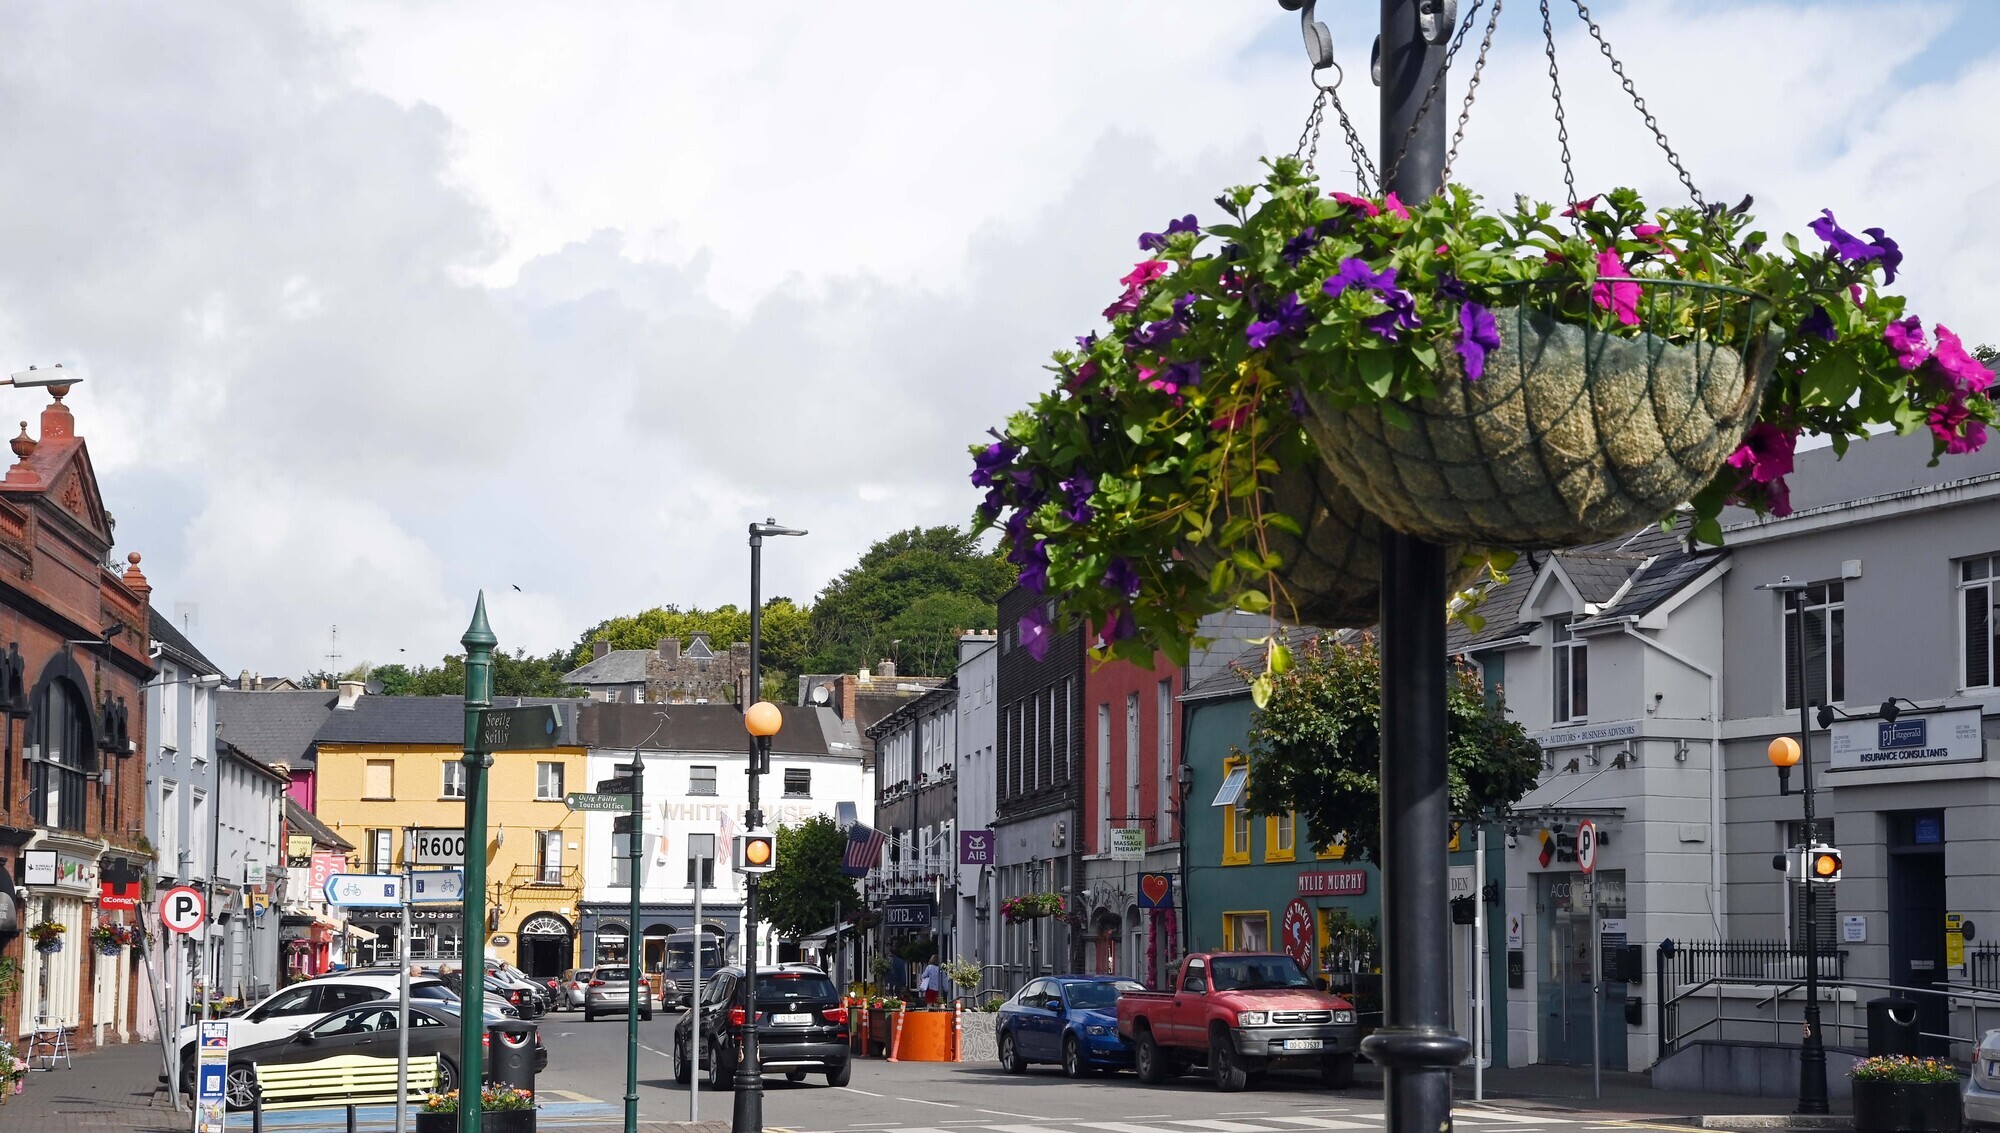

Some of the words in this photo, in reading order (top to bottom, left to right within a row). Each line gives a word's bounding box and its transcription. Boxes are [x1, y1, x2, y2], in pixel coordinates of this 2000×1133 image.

[485, 713, 511, 729] Sceilg
[484, 729, 510, 745] Scilly
[1550, 734, 1577, 744] AUDITORS
[1581, 730, 1606, 741] BUSINESS
[1608, 726, 1635, 737] ADVISORS
[1860, 751, 1897, 763] INSURANCE
[1899, 748, 1948, 761] CONSULTANTS
[578, 794, 595, 803] Oifig
[602, 802, 624, 810] Office
[659, 803, 729, 821] WHITE
[419, 837, 464, 856] R600
[1583, 831, 1590, 860] P
[967, 851, 987, 861] AIB
[1298, 876, 1324, 891] MYLIE
[1327, 873, 1363, 890] MURPHY
[175, 896, 193, 922] P
[887, 908, 913, 922] HOTEL
[1294, 902, 1312, 931] TACKLE
